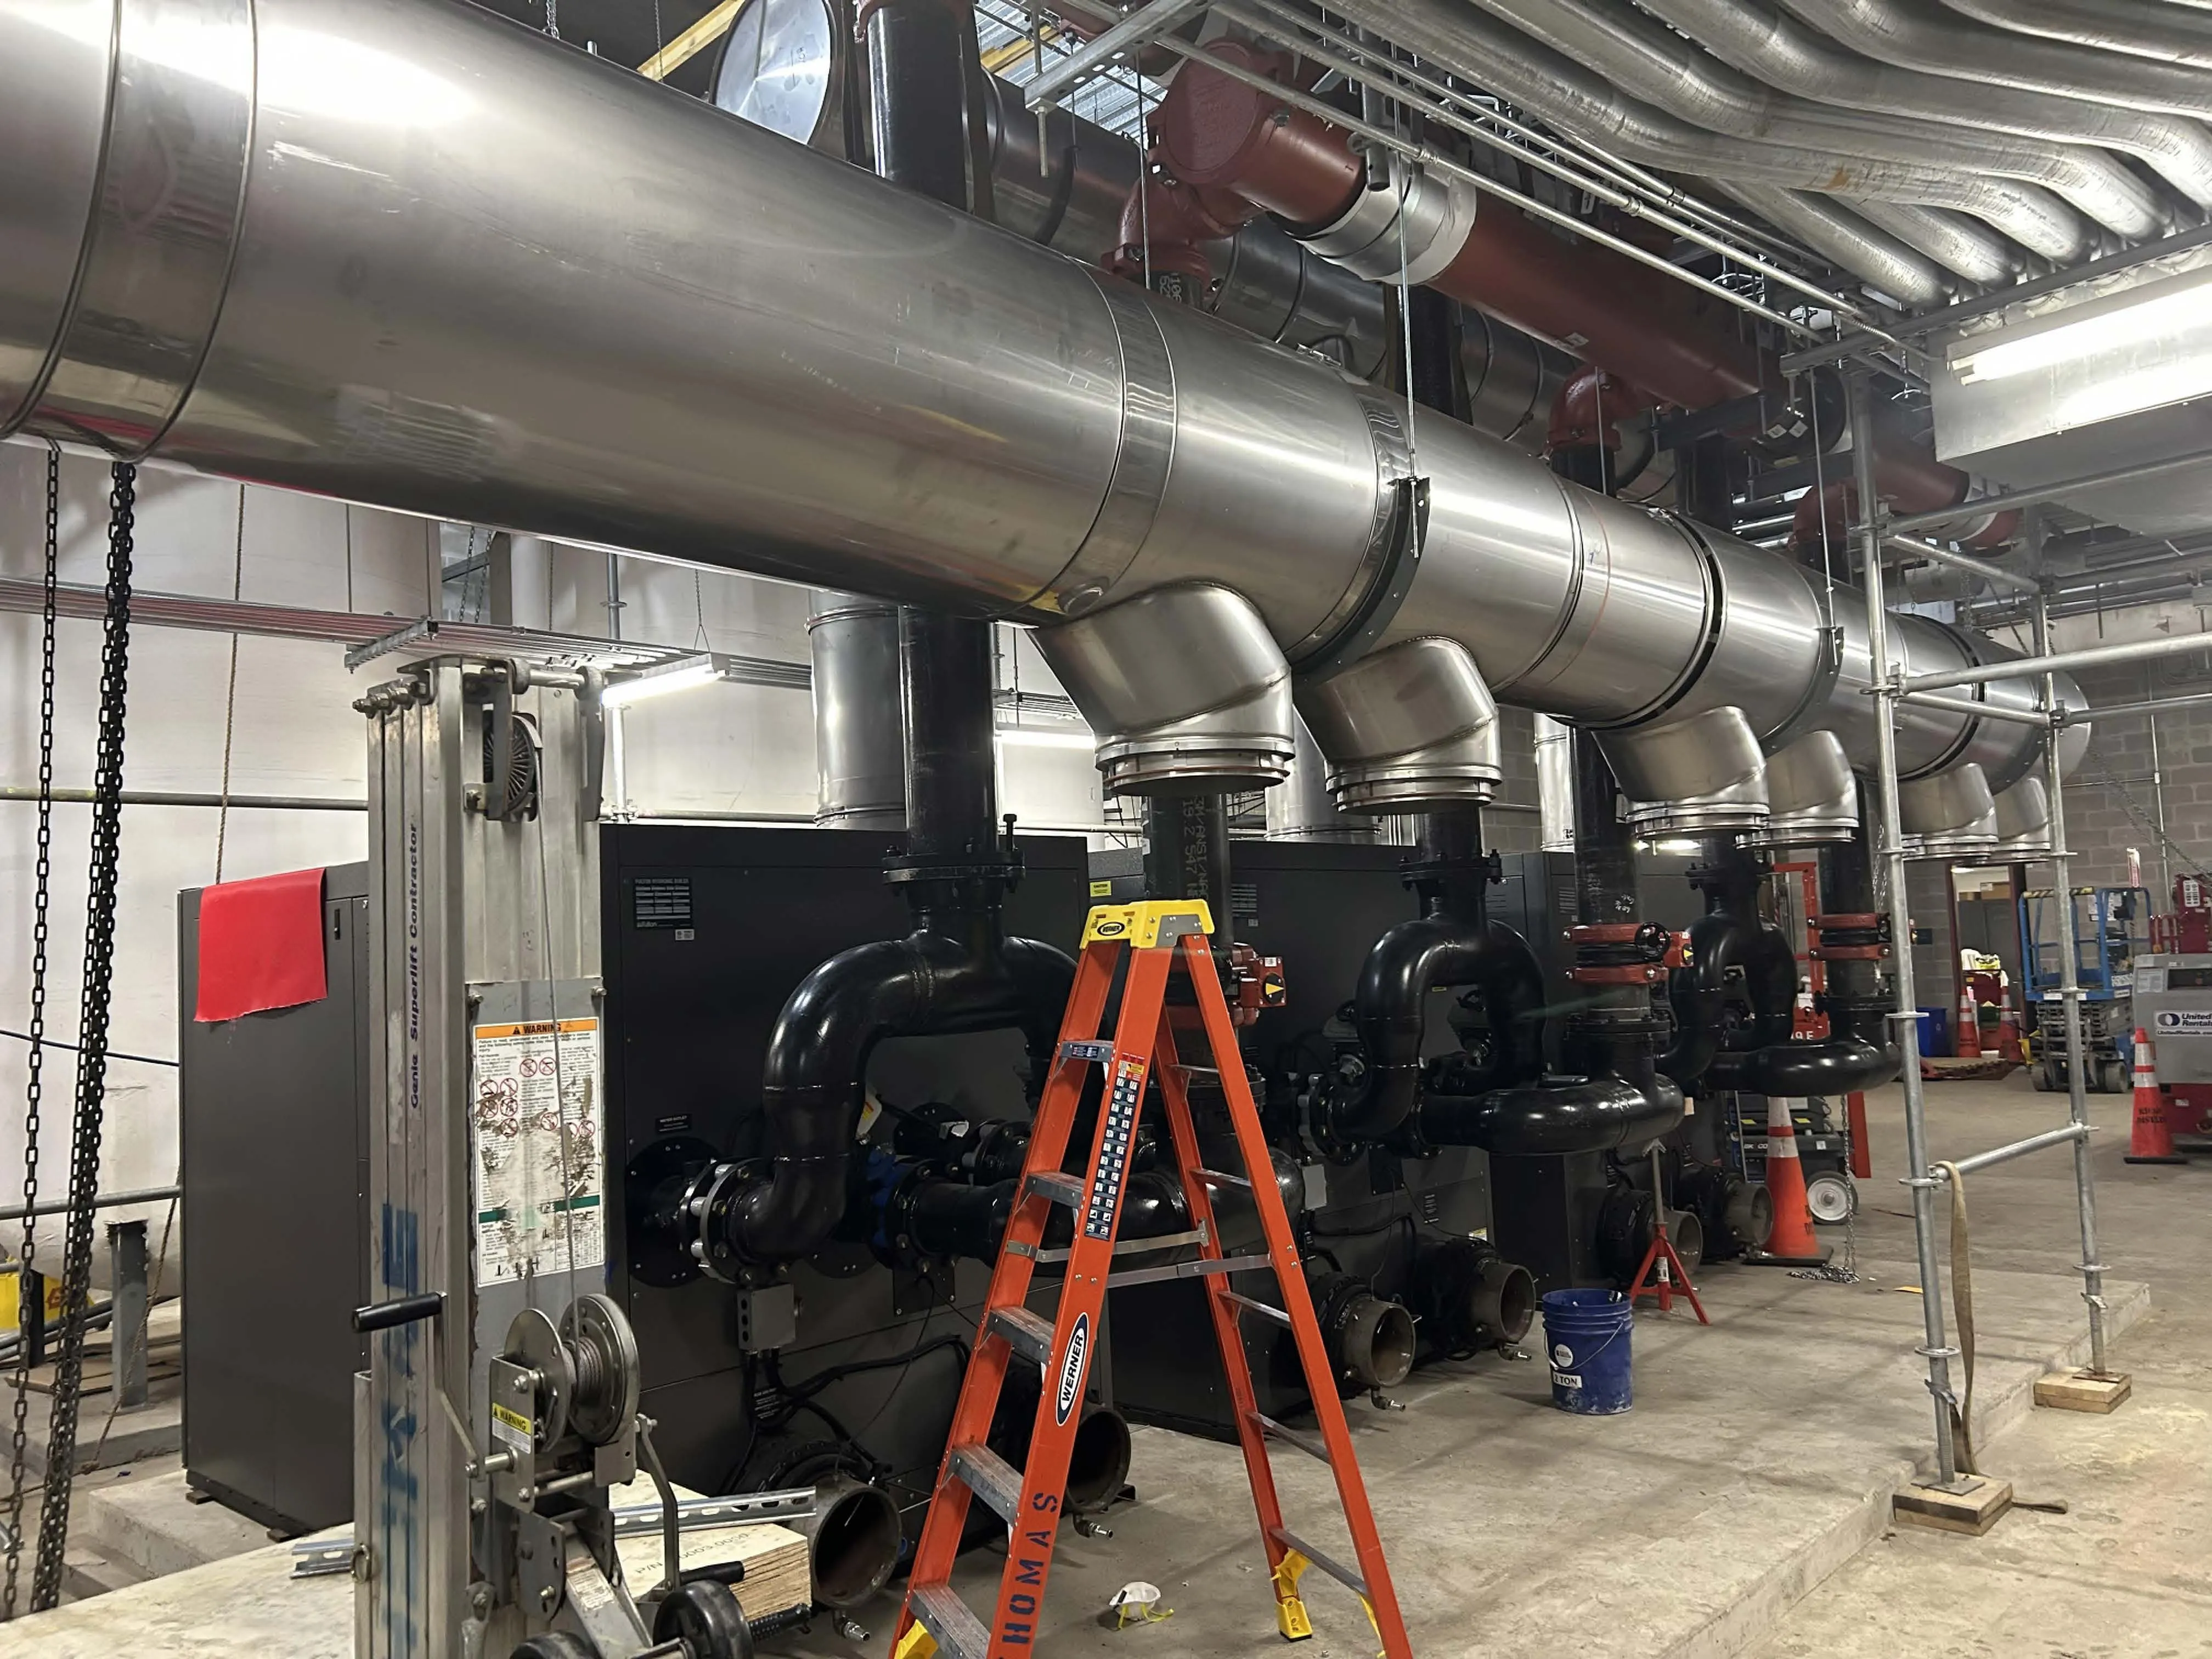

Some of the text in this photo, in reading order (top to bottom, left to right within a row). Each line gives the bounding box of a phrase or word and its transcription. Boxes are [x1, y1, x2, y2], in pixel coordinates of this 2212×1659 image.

[410, 823, 419, 1109] Genie Superlift Contractor
[1062, 1334, 1084, 1402] WERNER
[1560, 1376, 1577, 1386] TON
[998, 1492, 1058, 1659] HOMAS
